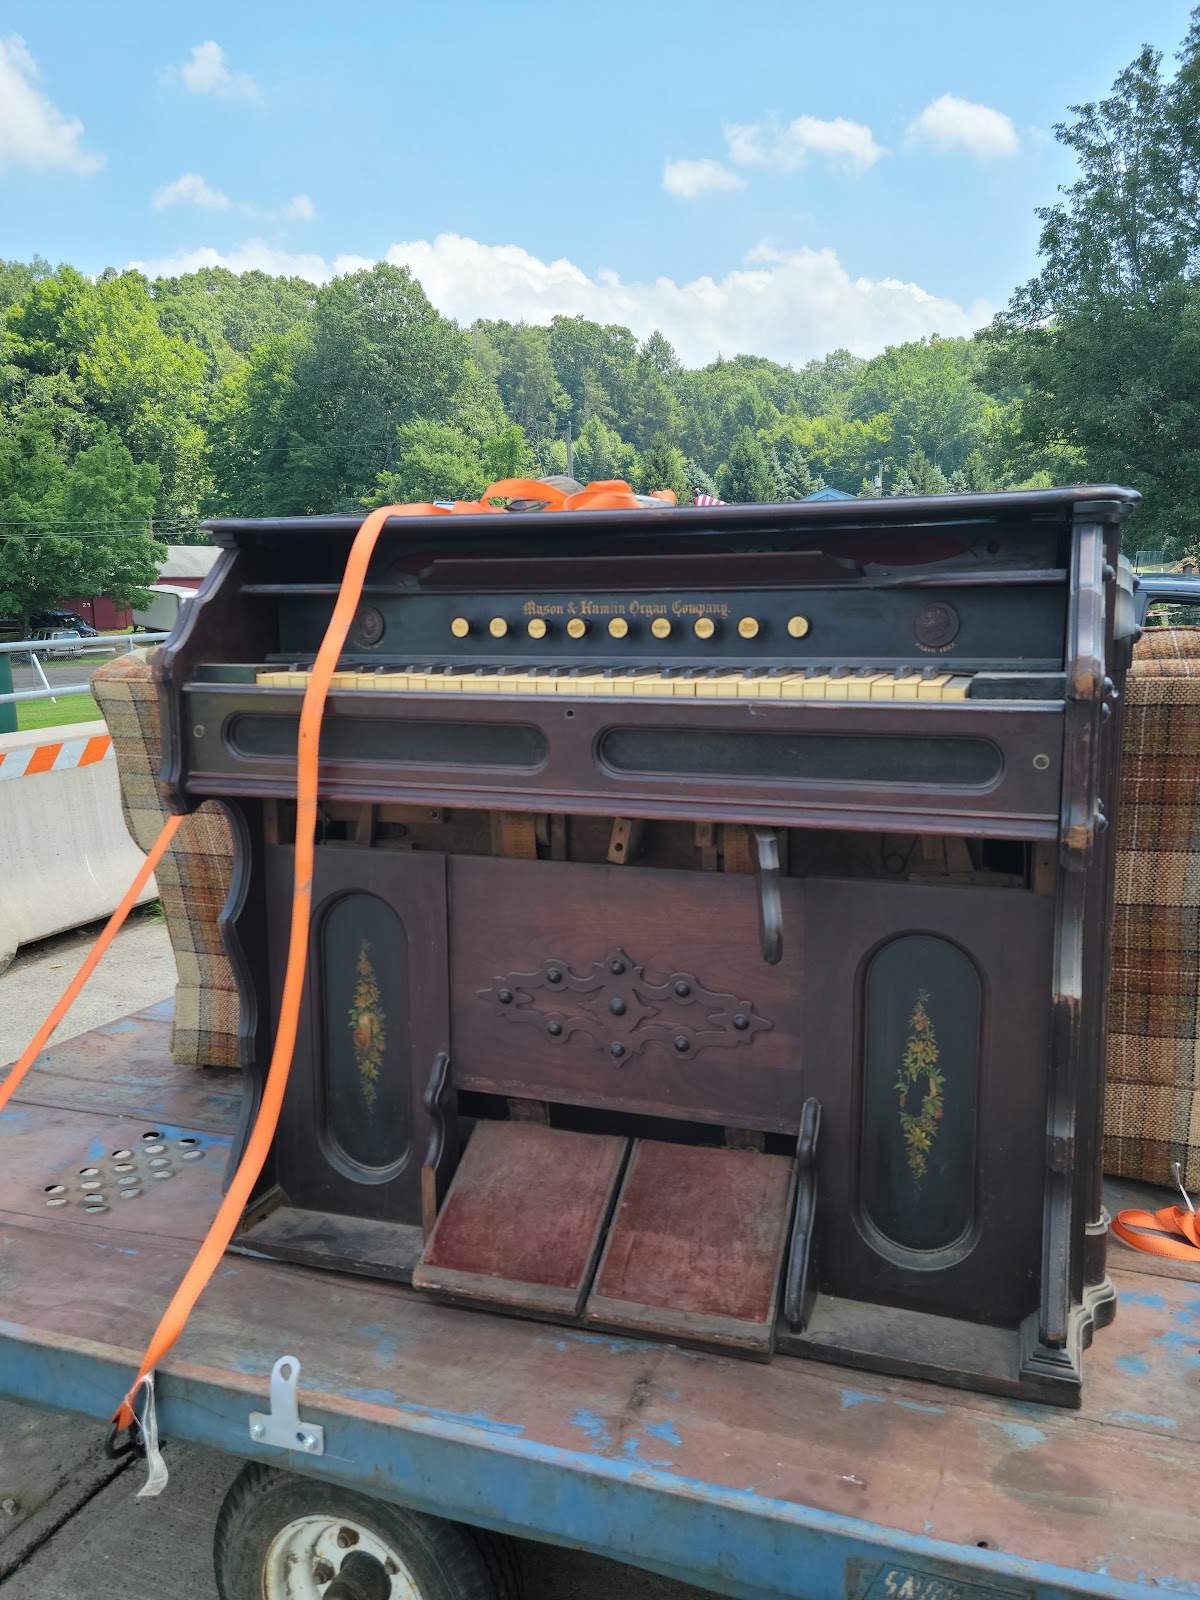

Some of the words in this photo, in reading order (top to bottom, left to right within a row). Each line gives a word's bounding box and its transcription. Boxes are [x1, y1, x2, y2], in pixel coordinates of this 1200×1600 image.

[523, 599, 563, 617] Mason
[567, 601, 577, 615] &
[629, 600, 667, 617] Organ
